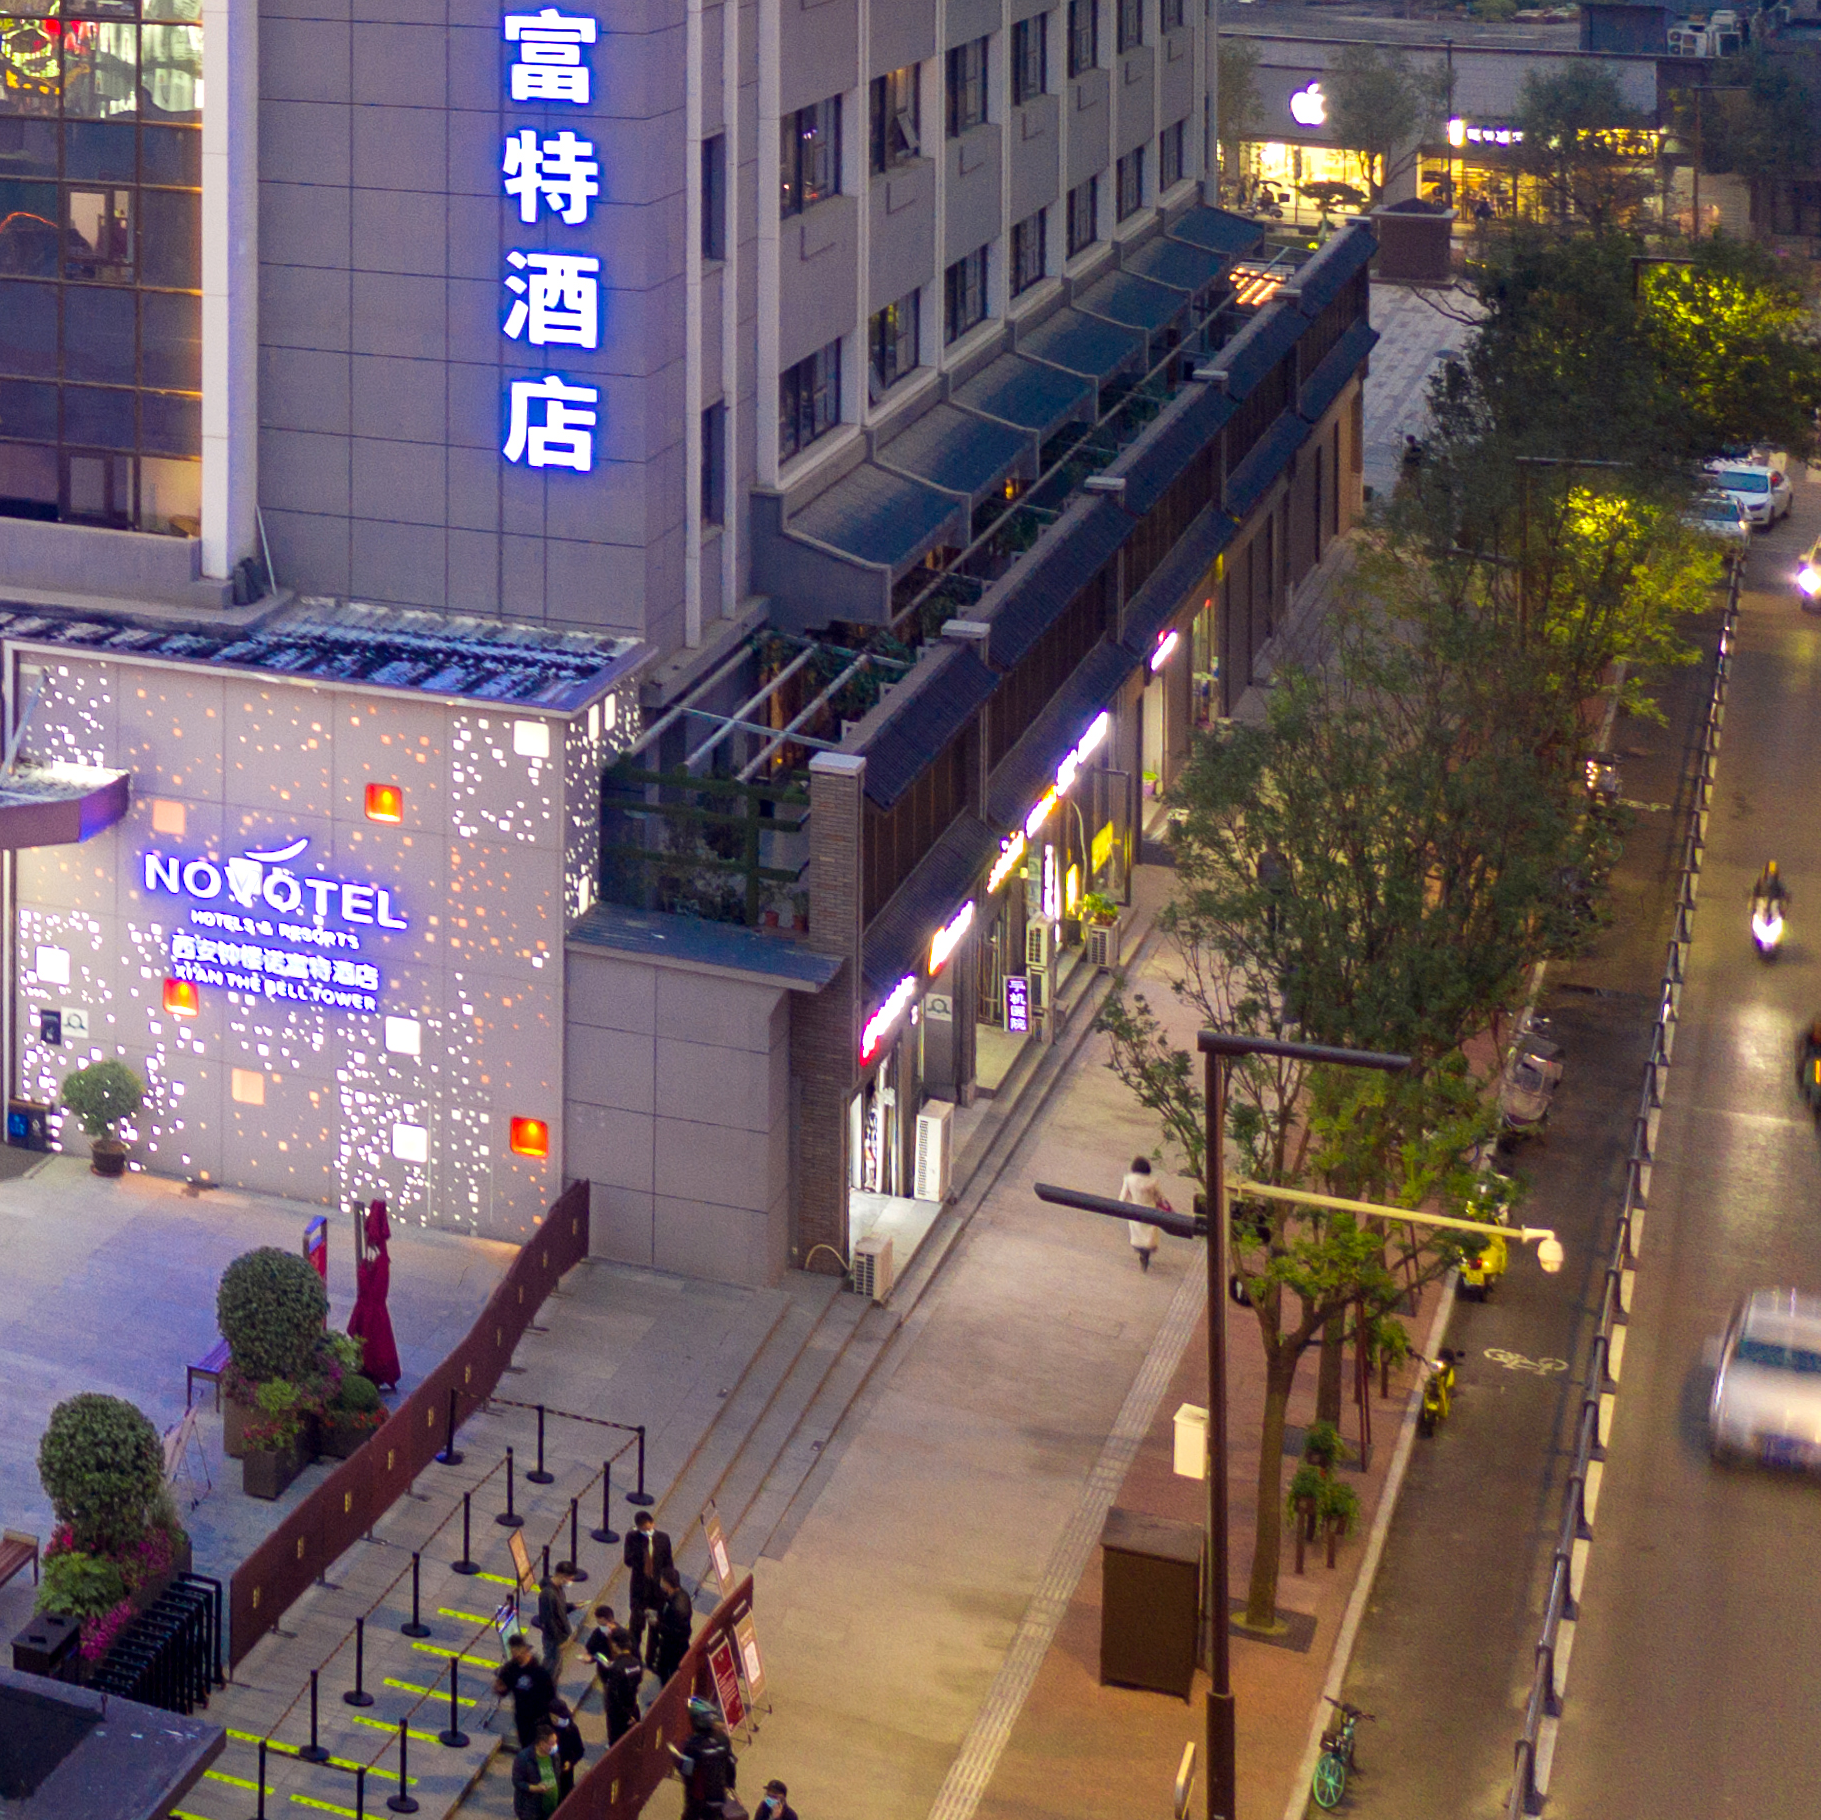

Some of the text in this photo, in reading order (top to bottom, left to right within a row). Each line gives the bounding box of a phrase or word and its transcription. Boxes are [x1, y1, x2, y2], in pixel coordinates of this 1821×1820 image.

[145, 853, 407, 929] NOVOTEL
[191, 910, 256, 935] HOTELS
[279, 923, 359, 950] RESORTS
[226, 972, 261, 993] THE
[264, 979, 308, 1001] BELL
[310, 986, 376, 1011] TOWER
